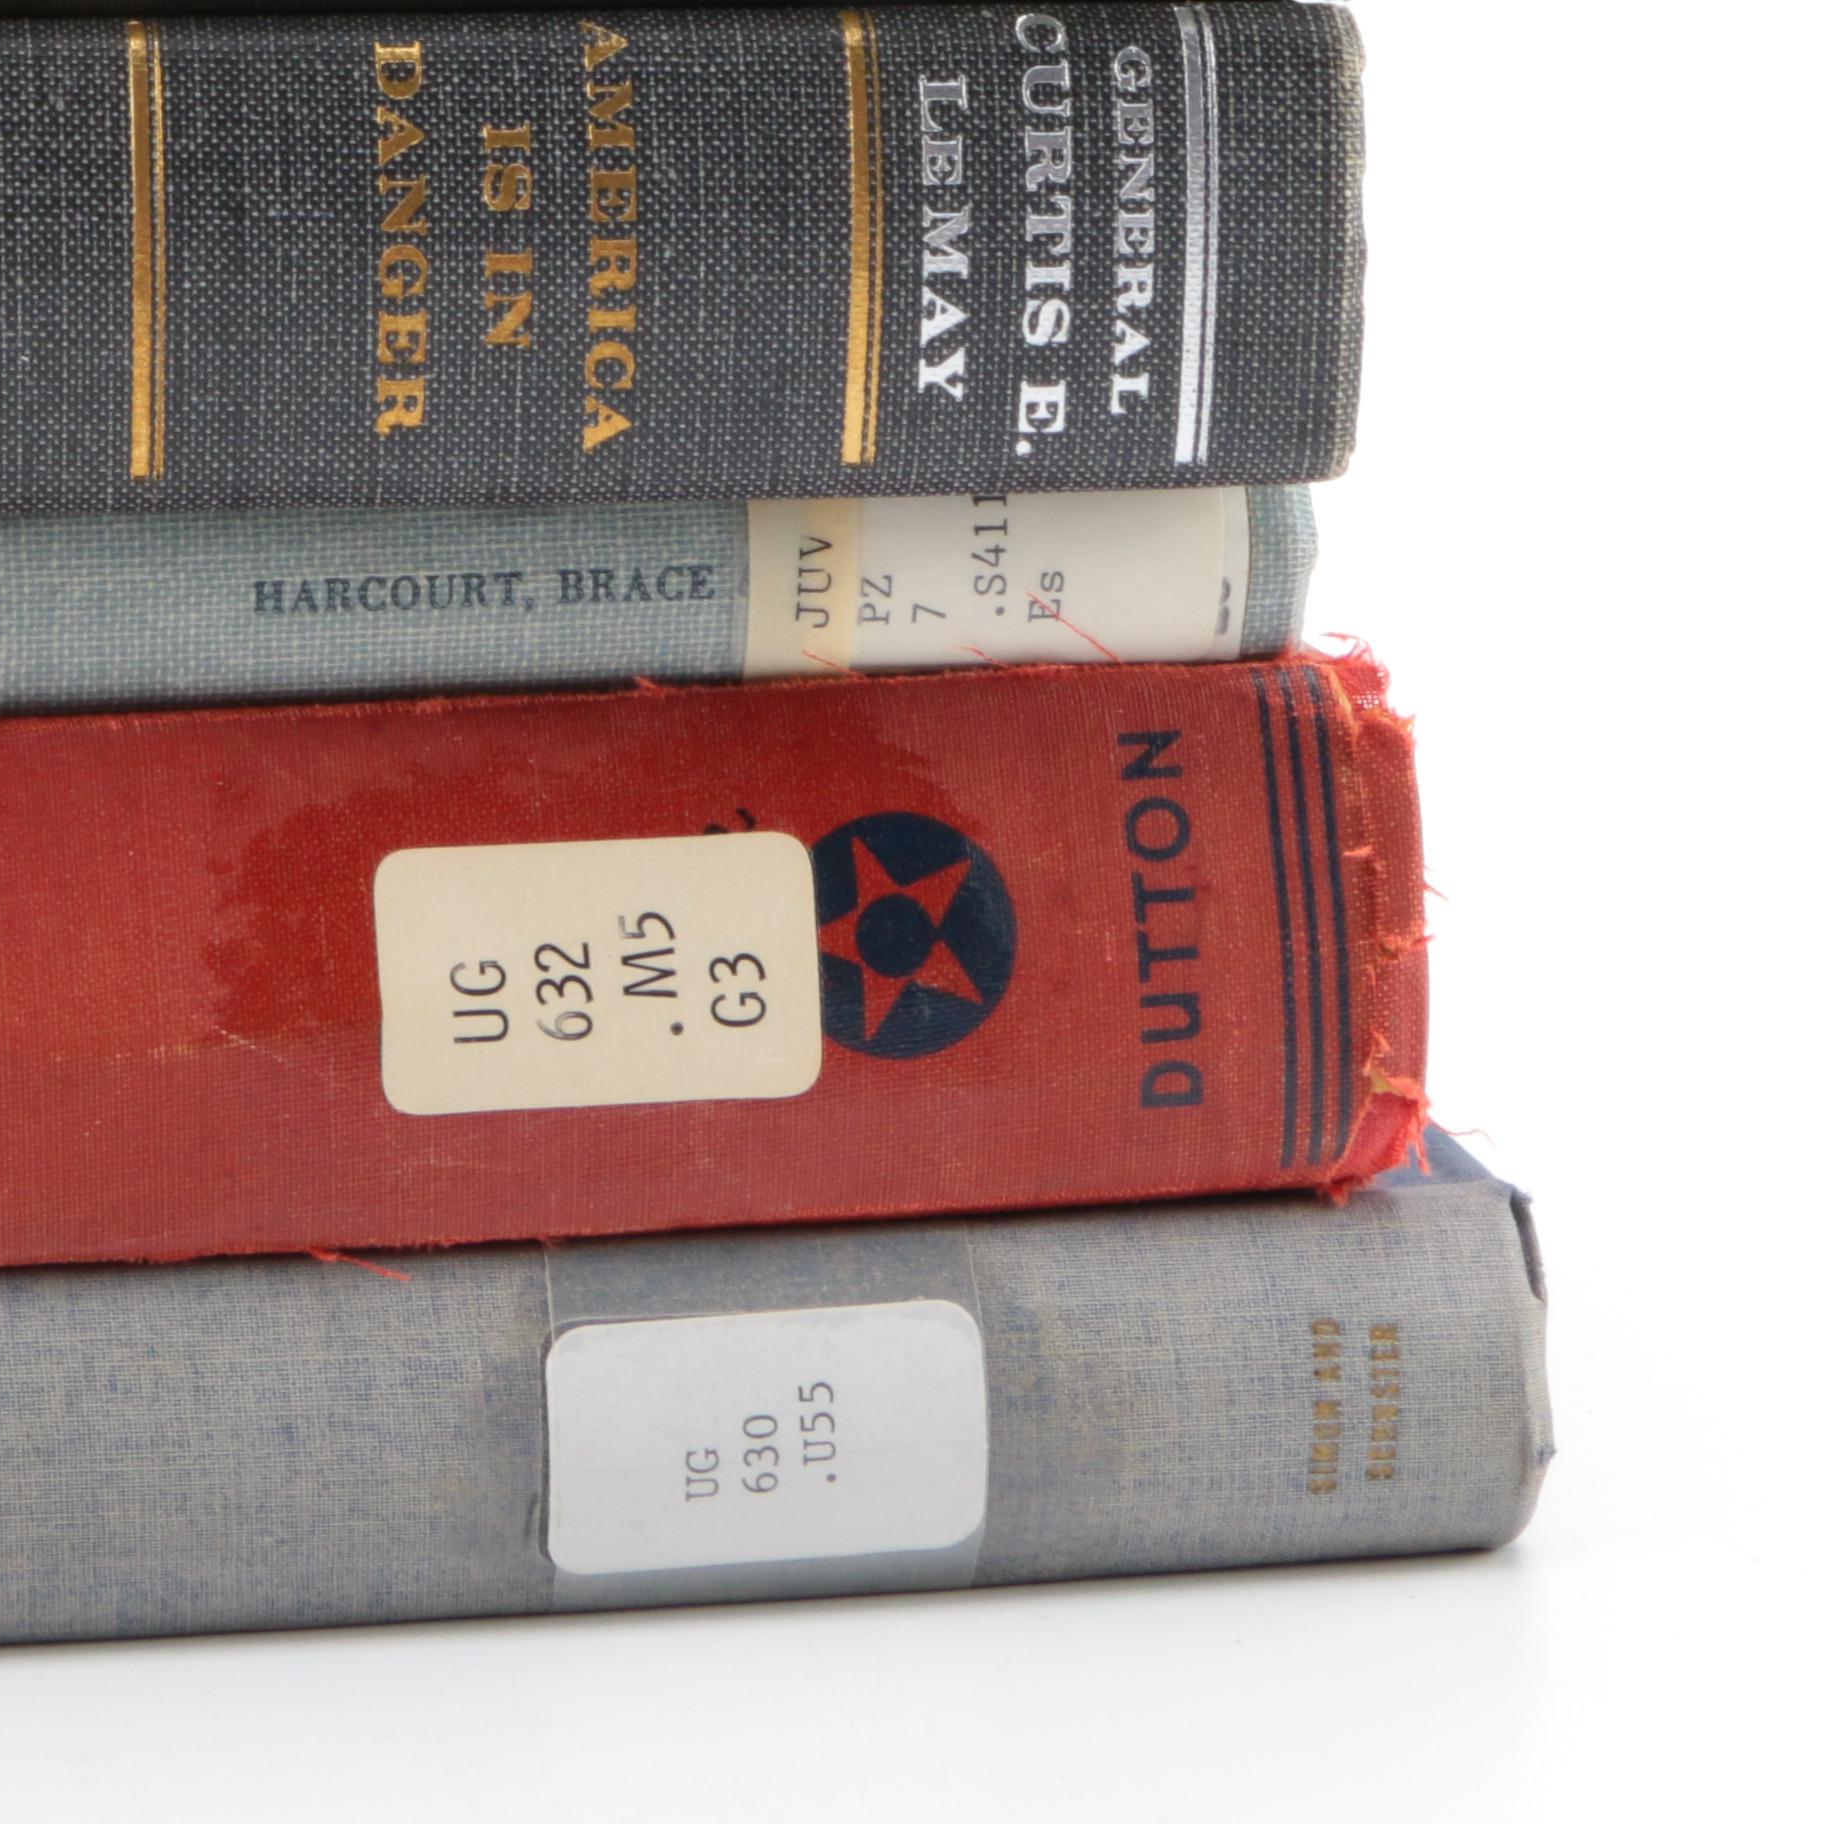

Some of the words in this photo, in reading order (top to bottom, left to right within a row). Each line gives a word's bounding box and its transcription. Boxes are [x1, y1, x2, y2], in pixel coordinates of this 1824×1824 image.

[482, 122, 532, 211] IS
[1014, 13, 1073, 348] CURTIS
[375, 40, 428, 436] DANGER
[581, 20, 639, 454] AMERICA
[1109, 44, 1155, 415] GENERAL
[483, 247, 532, 347] IN
[1015, 381, 1067, 456] E.
[253, 568, 539, 617] HARCOURT,
[558, 564, 716, 607] BRACE
[797, 533, 834, 631] JUV
[858, 572, 894, 626] PZ
[913, 603, 948, 624] 7
[1029, 570, 1065, 624] Es
[1117, 728, 1206, 1108] DUTTON
[449, 957, 509, 1045] UG
[533, 939, 594, 1042] 632
[617, 909, 685, 1037] .M5
[708, 950, 768, 1028] G3
[684, 1446, 720, 1503] UG
[740, 1412, 779, 1495] 630
[795, 1379, 839, 1484] .U55
